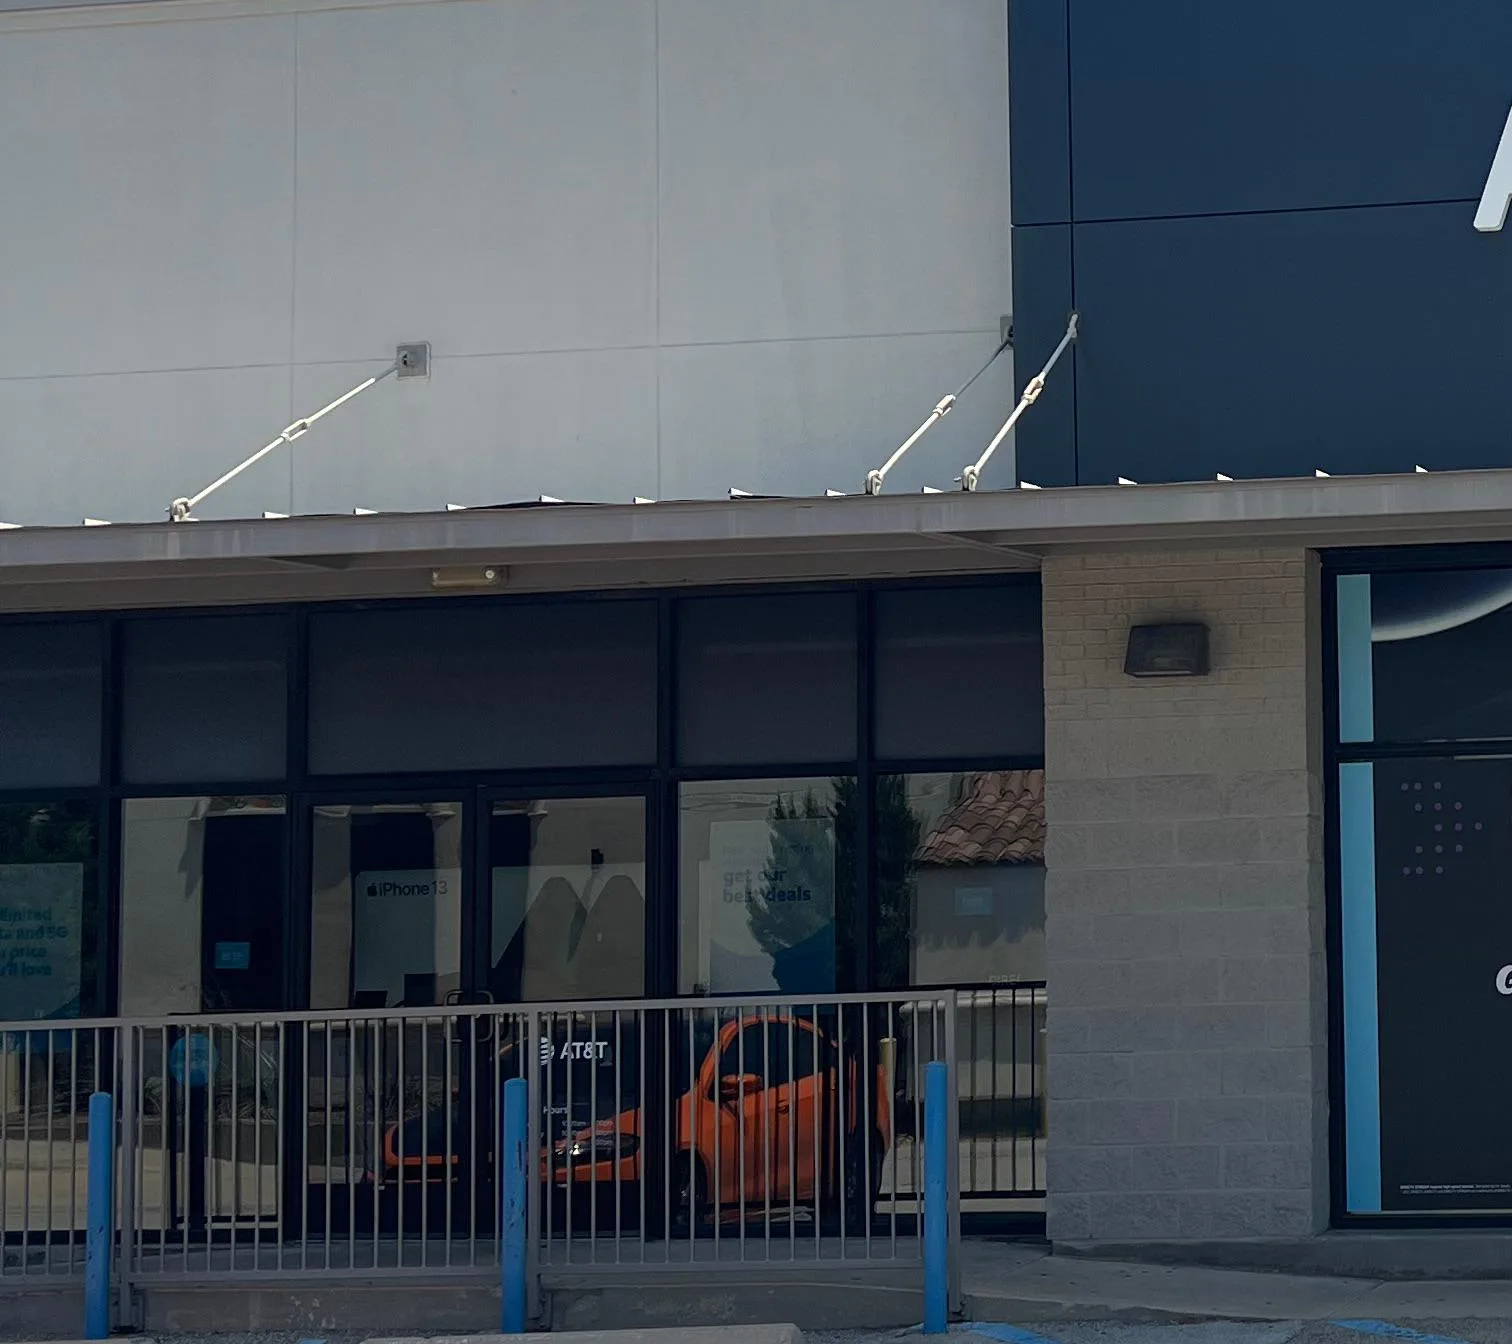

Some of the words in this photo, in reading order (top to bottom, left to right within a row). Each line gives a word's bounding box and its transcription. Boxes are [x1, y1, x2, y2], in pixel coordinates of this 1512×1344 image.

[379, 882, 430, 898] iPhone
[431, 880, 448, 895] 13
[766, 886, 811, 902] deals
[559, 1042, 608, 1061] AT&T
[543, 1106, 570, 1114] Hour
